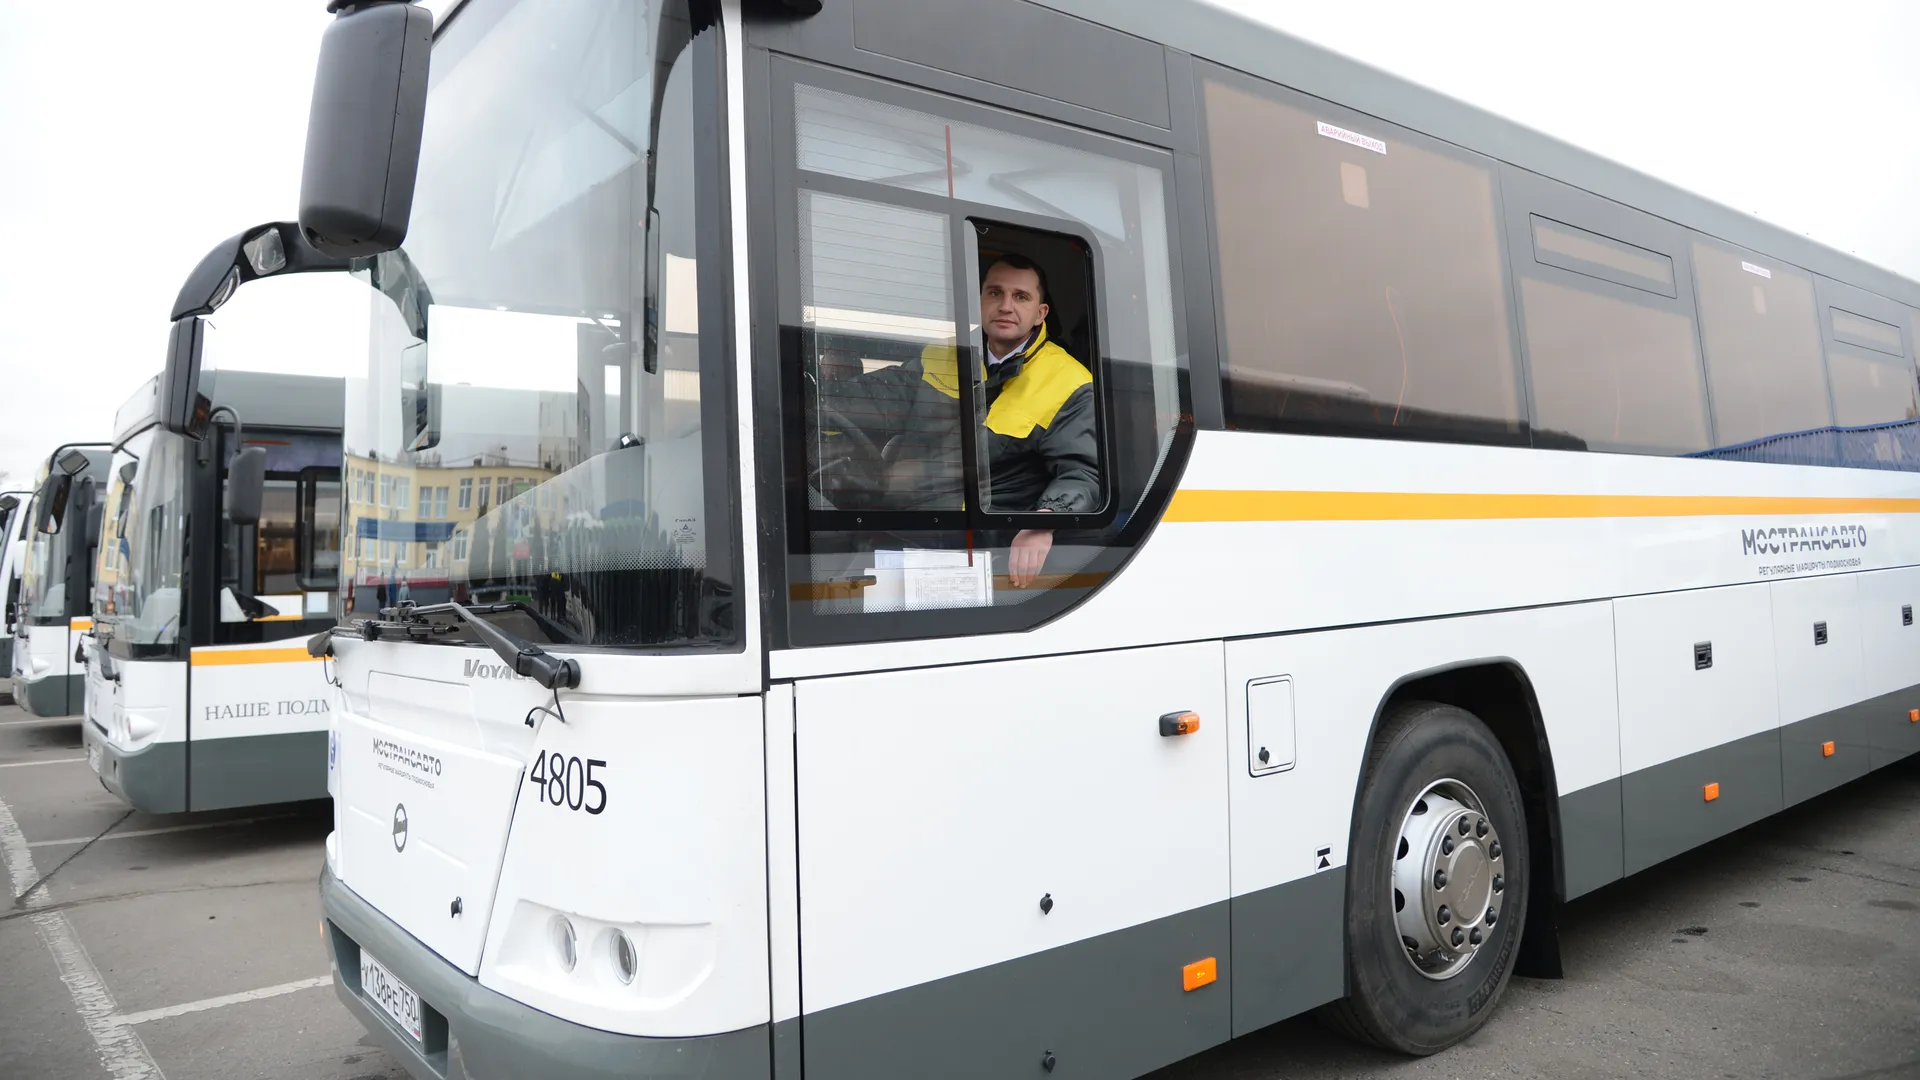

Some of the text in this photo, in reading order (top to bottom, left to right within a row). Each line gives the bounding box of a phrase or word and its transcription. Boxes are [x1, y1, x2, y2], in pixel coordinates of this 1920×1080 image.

[1321, 125, 1384, 151] АВАРИЙНЫЙ ВЫХОД
[1741, 525, 1867, 555] МОСТРАНСАВТО
[1759, 558, 1861, 576] РЕГУЛЯРНЫЕ МАРШРУТЫ ПОДМОСКОВЬЯ
[205, 702, 270, 720] НАШЕ
[373, 737, 442, 776] МОСТРАНСАВТО
[530, 750, 607, 815] 4805
